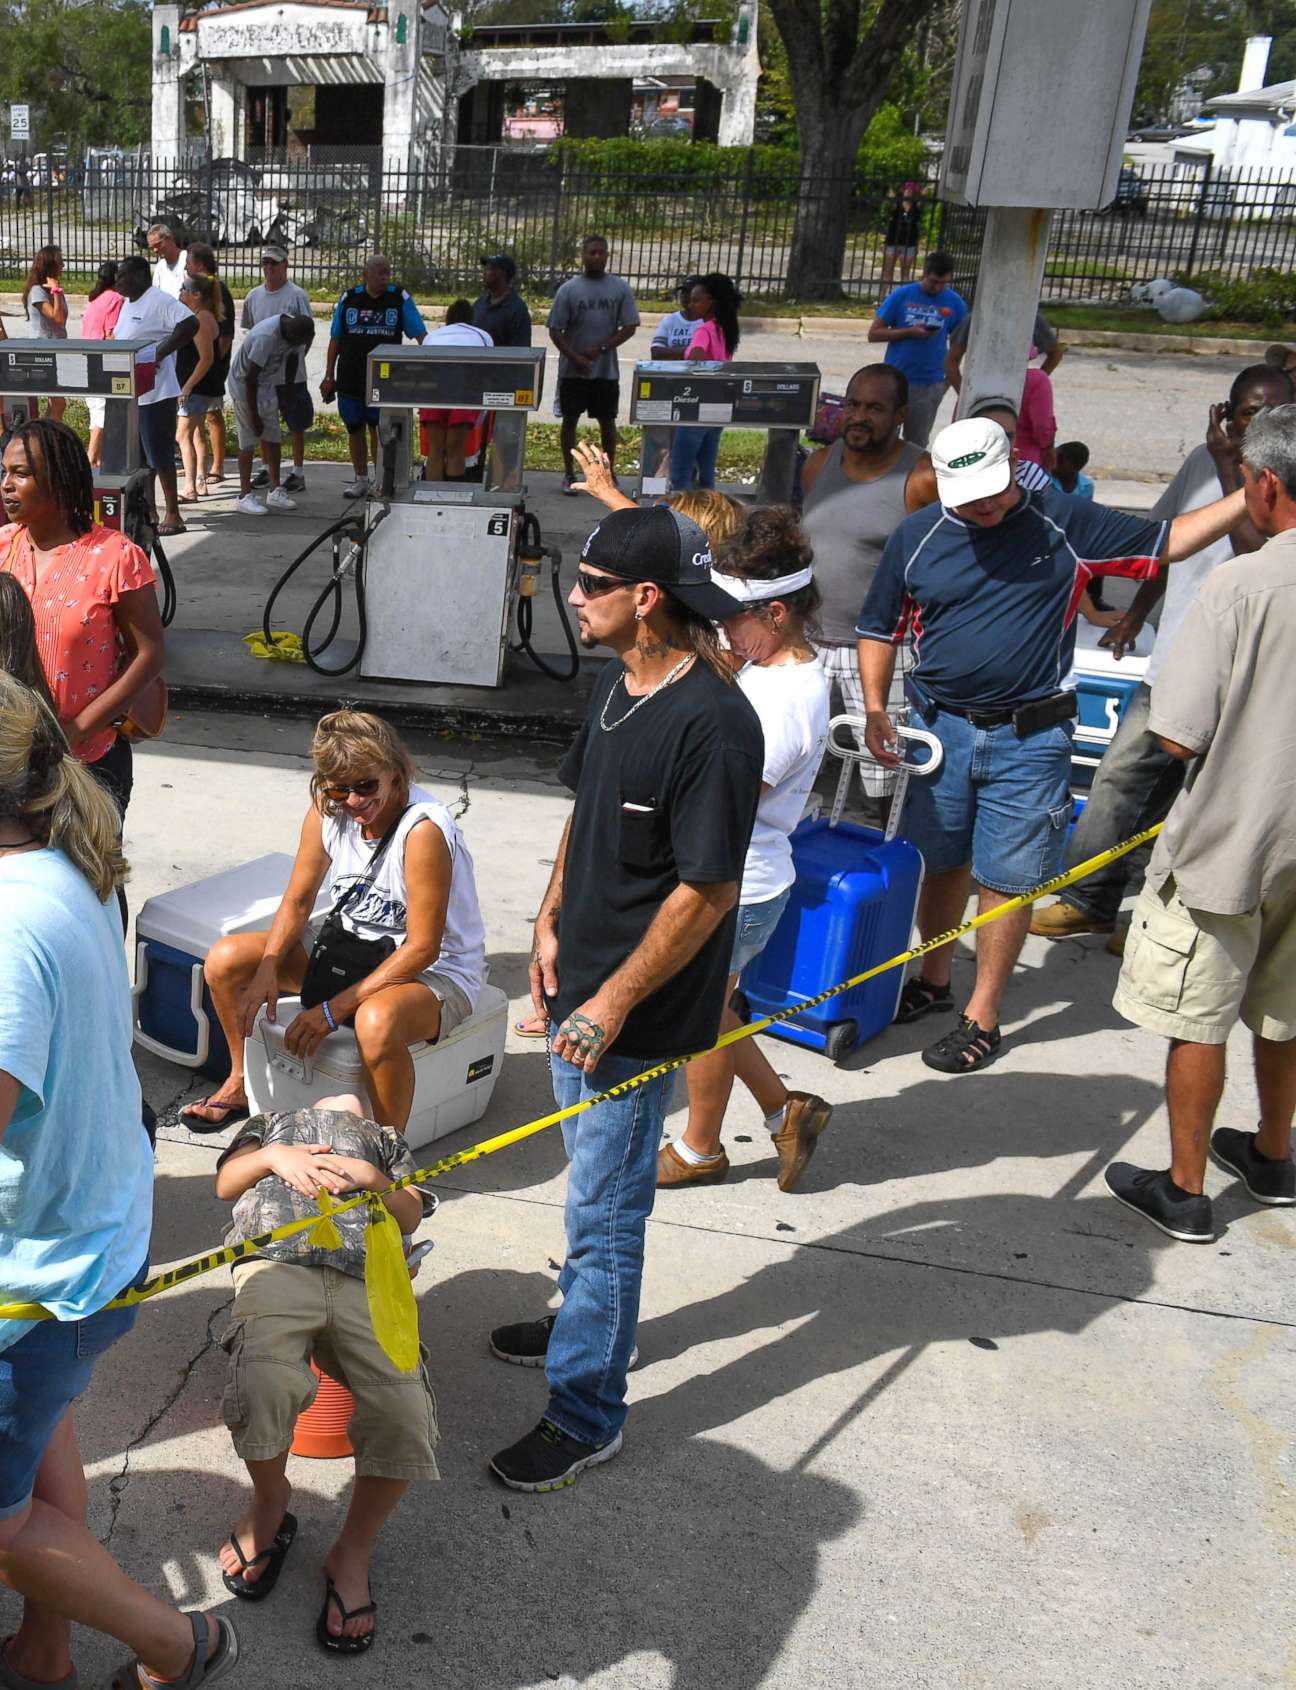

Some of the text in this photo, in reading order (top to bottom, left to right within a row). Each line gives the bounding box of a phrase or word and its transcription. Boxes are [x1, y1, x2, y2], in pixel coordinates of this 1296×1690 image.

[13, 118, 28, 128] 25
[577, 298, 619, 311] ARMY
[683, 386, 693, 396] 2
[673, 395, 700, 403] Diesel
[106, 503, 115, 516] 3
[494, 521, 504, 534] 5
